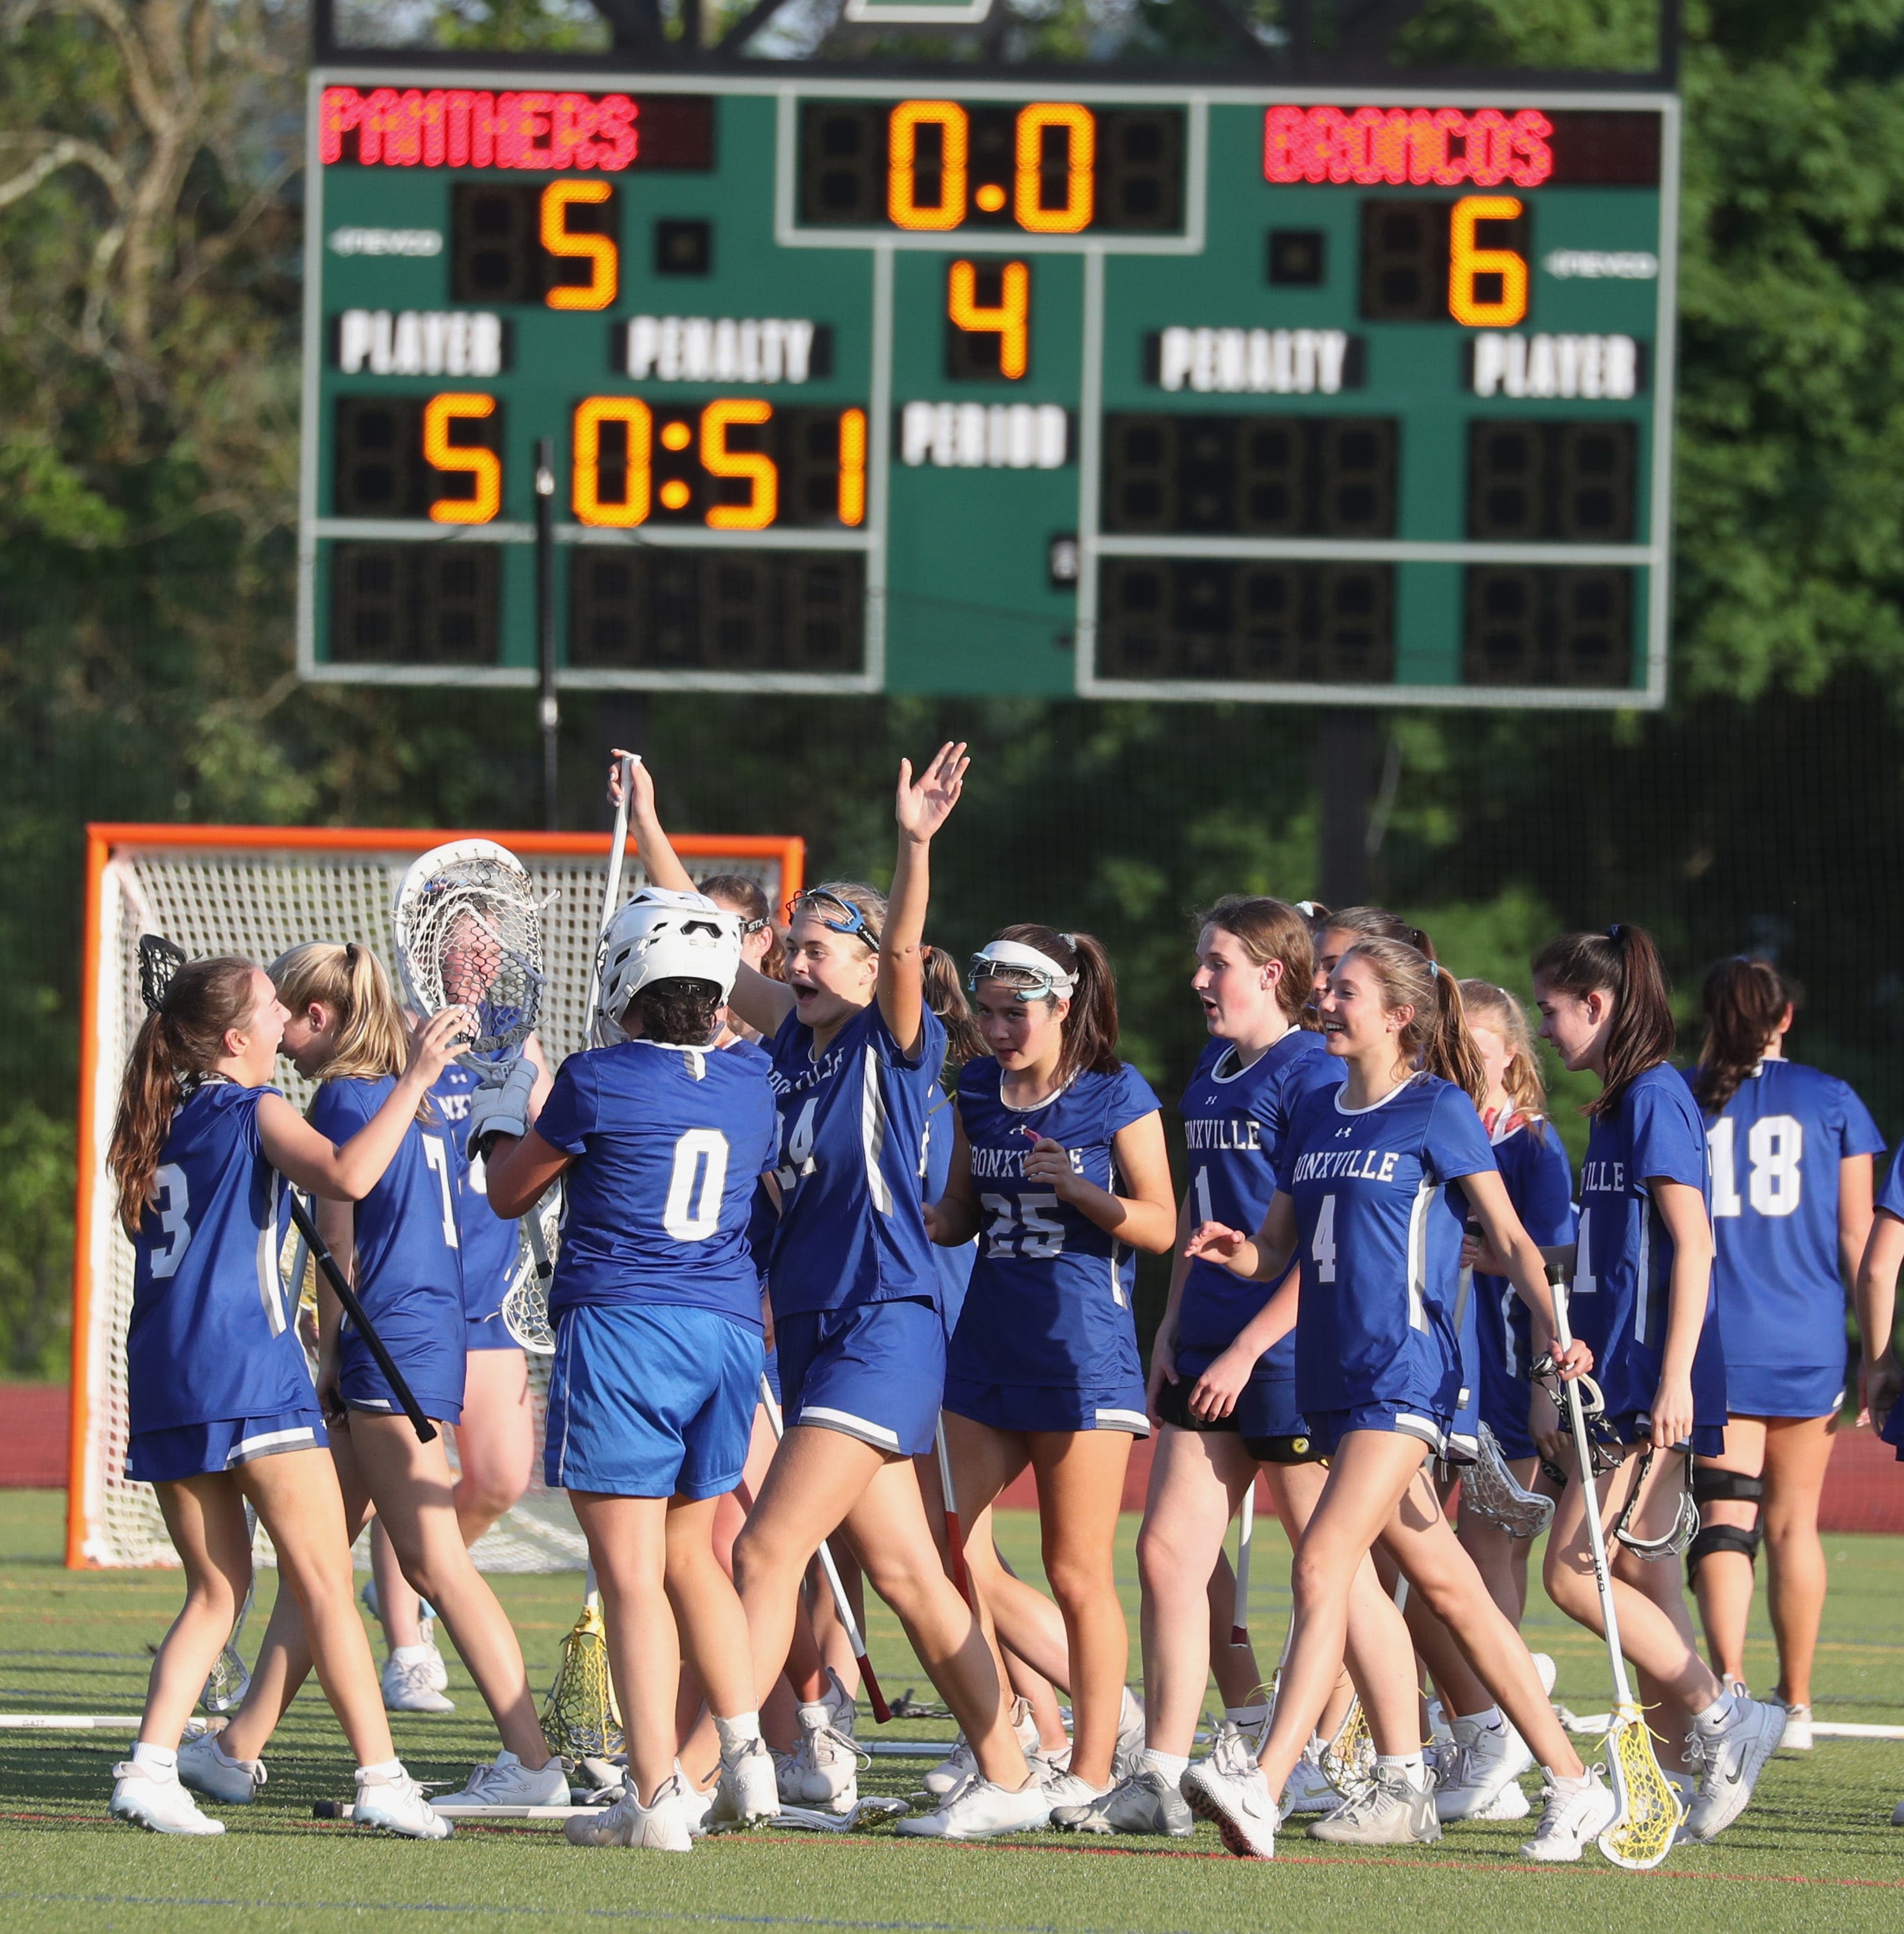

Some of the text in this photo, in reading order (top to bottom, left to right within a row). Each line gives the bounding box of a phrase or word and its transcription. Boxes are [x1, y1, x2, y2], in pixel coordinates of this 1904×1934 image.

[320, 86, 638, 171] PANTHERS
[889, 100, 1094, 233] 0.0
[1264, 104, 1554, 187] BRONCOS
[540, 179, 618, 311] 5
[1449, 196, 1528, 327] 6
[341, 309, 501, 377] PLAYER
[627, 316, 814, 383] PENALTY
[948, 261, 1028, 380] 4
[1161, 326, 1347, 394] PENALTY
[1474, 332, 1636, 399] PLAYER
[424, 393, 501, 525] 5
[572, 396, 866, 531] 0:51
[903, 401, 1066, 469] PERIOD
[748, 920, 764, 932] STX
[421, 1133, 459, 1250] 7
[662, 1128, 731, 1242] 0
[1706, 1115, 1803, 1217] 18
[145, 1163, 191, 1279] 3
[980, 1193, 1066, 1259] 25
[1312, 1194, 1336, 1282] 4
[1594, 1558, 1605, 1592] GAIT
